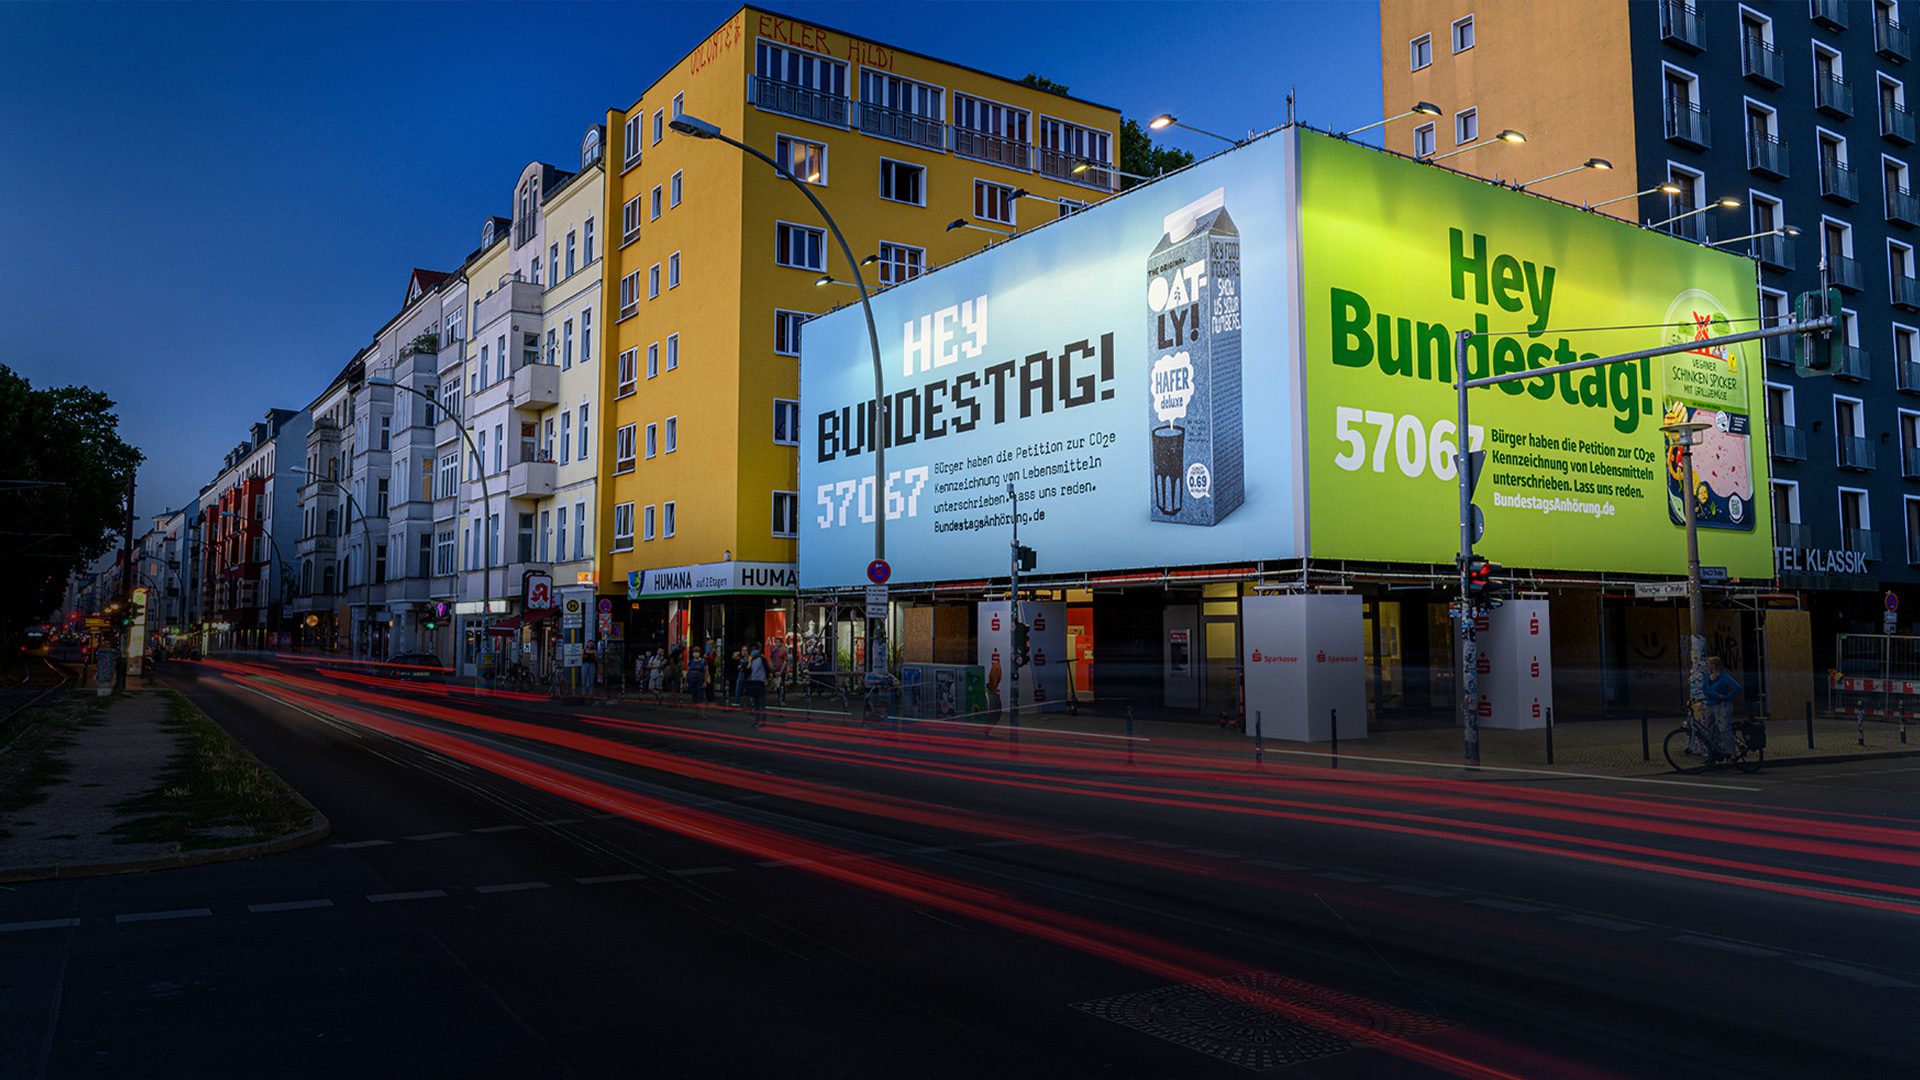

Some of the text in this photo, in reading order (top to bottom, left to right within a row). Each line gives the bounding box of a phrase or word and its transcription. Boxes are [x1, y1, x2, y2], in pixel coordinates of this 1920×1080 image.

[758, 15, 831, 55] EKLER
[1449, 227, 1556, 337] Hey
[903, 293, 989, 377] HEY
[1158, 303, 1199, 349] LY!
[1330, 286, 1653, 434] Bundestag!
[1155, 367, 1190, 394] HAFER
[818, 332, 1115, 463] BUNDESTAG!
[1161, 396, 1184, 410] deluxe
[934, 460, 964, 475] Bürger
[967, 454, 993, 470] haben
[996, 449, 1013, 463] die
[1016, 440, 1063, 460] Petition
[1066, 437, 1085, 450] zur
[1491, 428, 1527, 448] Bürger
[1529, 433, 1560, 450] haben
[1562, 437, 1577, 452] die
[1579, 440, 1615, 457] Petition
[1617, 447, 1632, 459] zur
[934, 456, 1102, 494] Kennzeichnung von Lebensmitteln
[1492, 450, 1654, 480] Kennzeichnung von Lebensmitteln
[817, 465, 929, 529] 57067
[934, 480, 1097, 514] unterschrieben. ass uns reden.
[1189, 476, 1207, 488] 0.69
[1493, 472, 1644, 498] unterschrieben. Lass uns reden.
[1493, 492, 1615, 518] BundestagsAnhörung.de
[1806, 548, 1868, 574] KLASSIK
[654, 571, 692, 591] HUMANA
[1263, 655, 1298, 664] Sparkasse
[1327, 655, 1358, 664] Sparkasse
